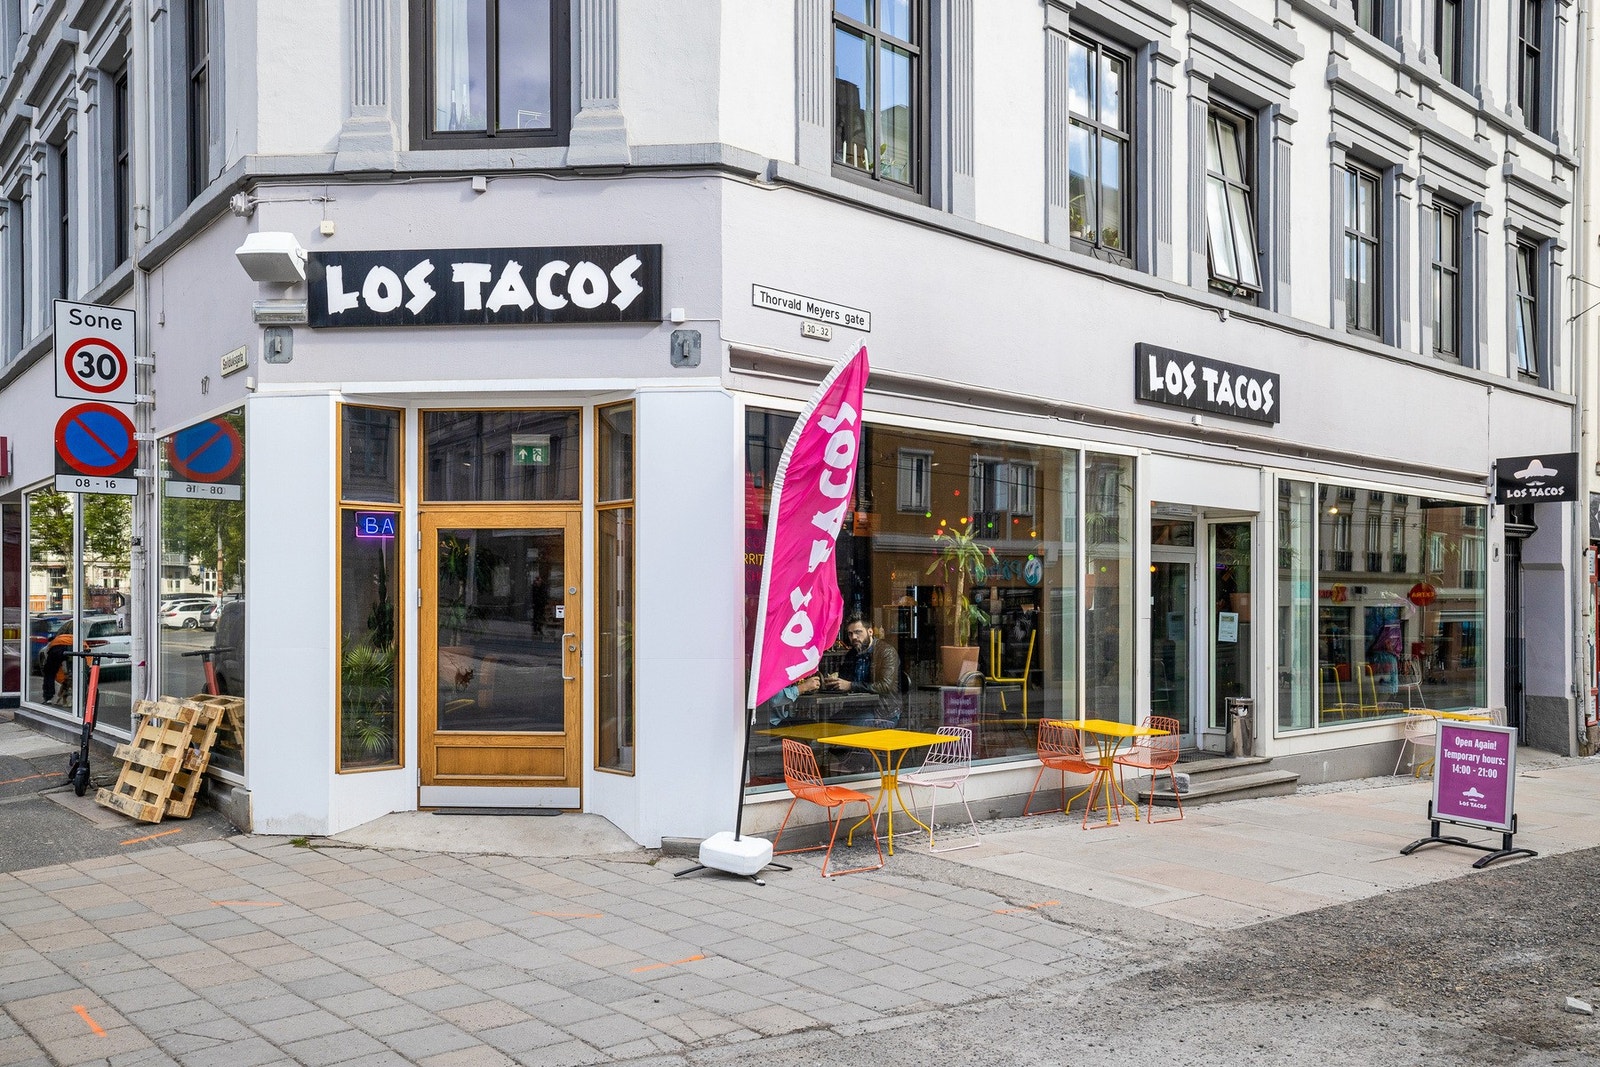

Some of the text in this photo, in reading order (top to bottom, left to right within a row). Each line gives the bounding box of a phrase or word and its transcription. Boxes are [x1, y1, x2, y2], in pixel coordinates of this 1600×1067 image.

[326, 253, 644, 316] LOS TACOS
[760, 291, 865, 327] Thorvald Meyers gate
[69, 309, 122, 331] Sone
[806, 324, 816, 334] 30
[820, 326, 829, 337] 32
[77, 351, 117, 381] 30
[1149, 354, 1274, 415] LOS TACOS
[75, 478, 90, 489] 08
[105, 480, 116, 489] 16
[1507, 486, 1565, 498] LOS TACOS
[365, 517, 394, 534] BA
[744, 553, 764, 566] RRIT
[1455, 736, 1497, 750] Open Again!
[1444, 749, 1506, 766] Temporary hours:
[1452, 764, 1471, 775] 14:00
[1478, 767, 1498, 779] 21:00
